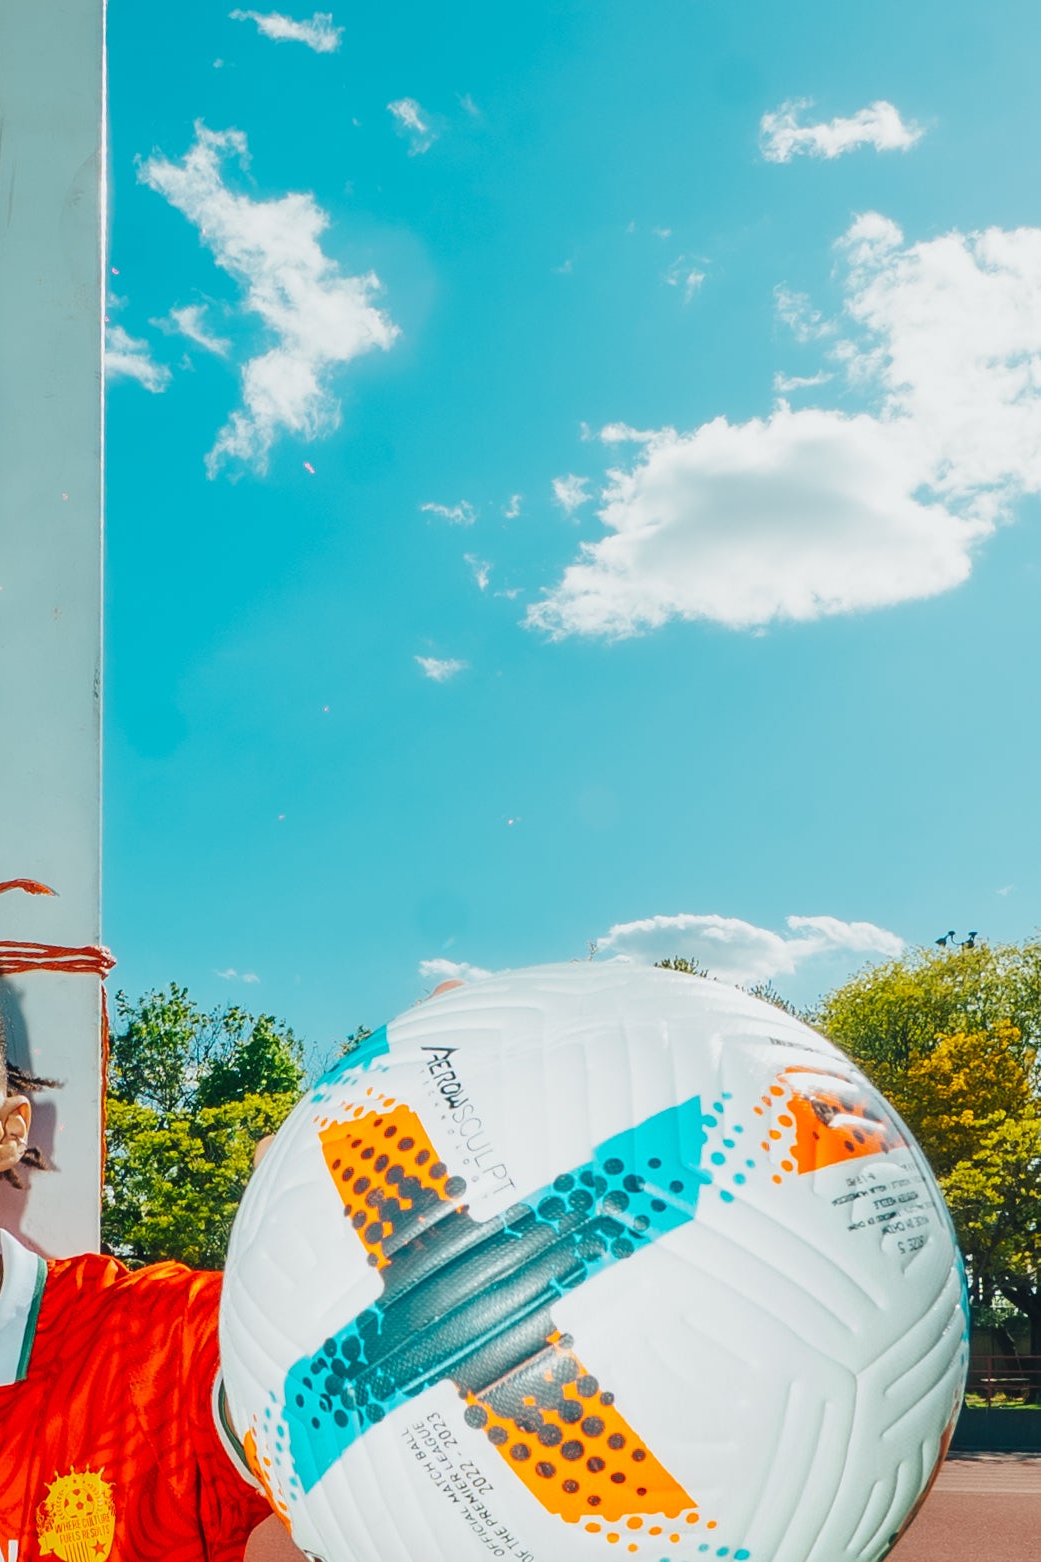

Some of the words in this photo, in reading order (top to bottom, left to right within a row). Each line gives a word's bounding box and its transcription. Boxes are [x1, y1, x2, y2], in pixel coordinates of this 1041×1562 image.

[401, 1428, 427, 1461] BALL
[412, 1421, 453, 1471] LEAGUE
[426, 1412, 458, 1449] 2023
[423, 1463, 460, 1504] MATCH
[458, 1460, 494, 1496] 2022
[449, 1472, 498, 1527] PREMIER
[59, 1530, 81, 1545] FUELS
[460, 1506, 505, 1557] OFFICIAL
[494, 1526, 520, 1550] THE
